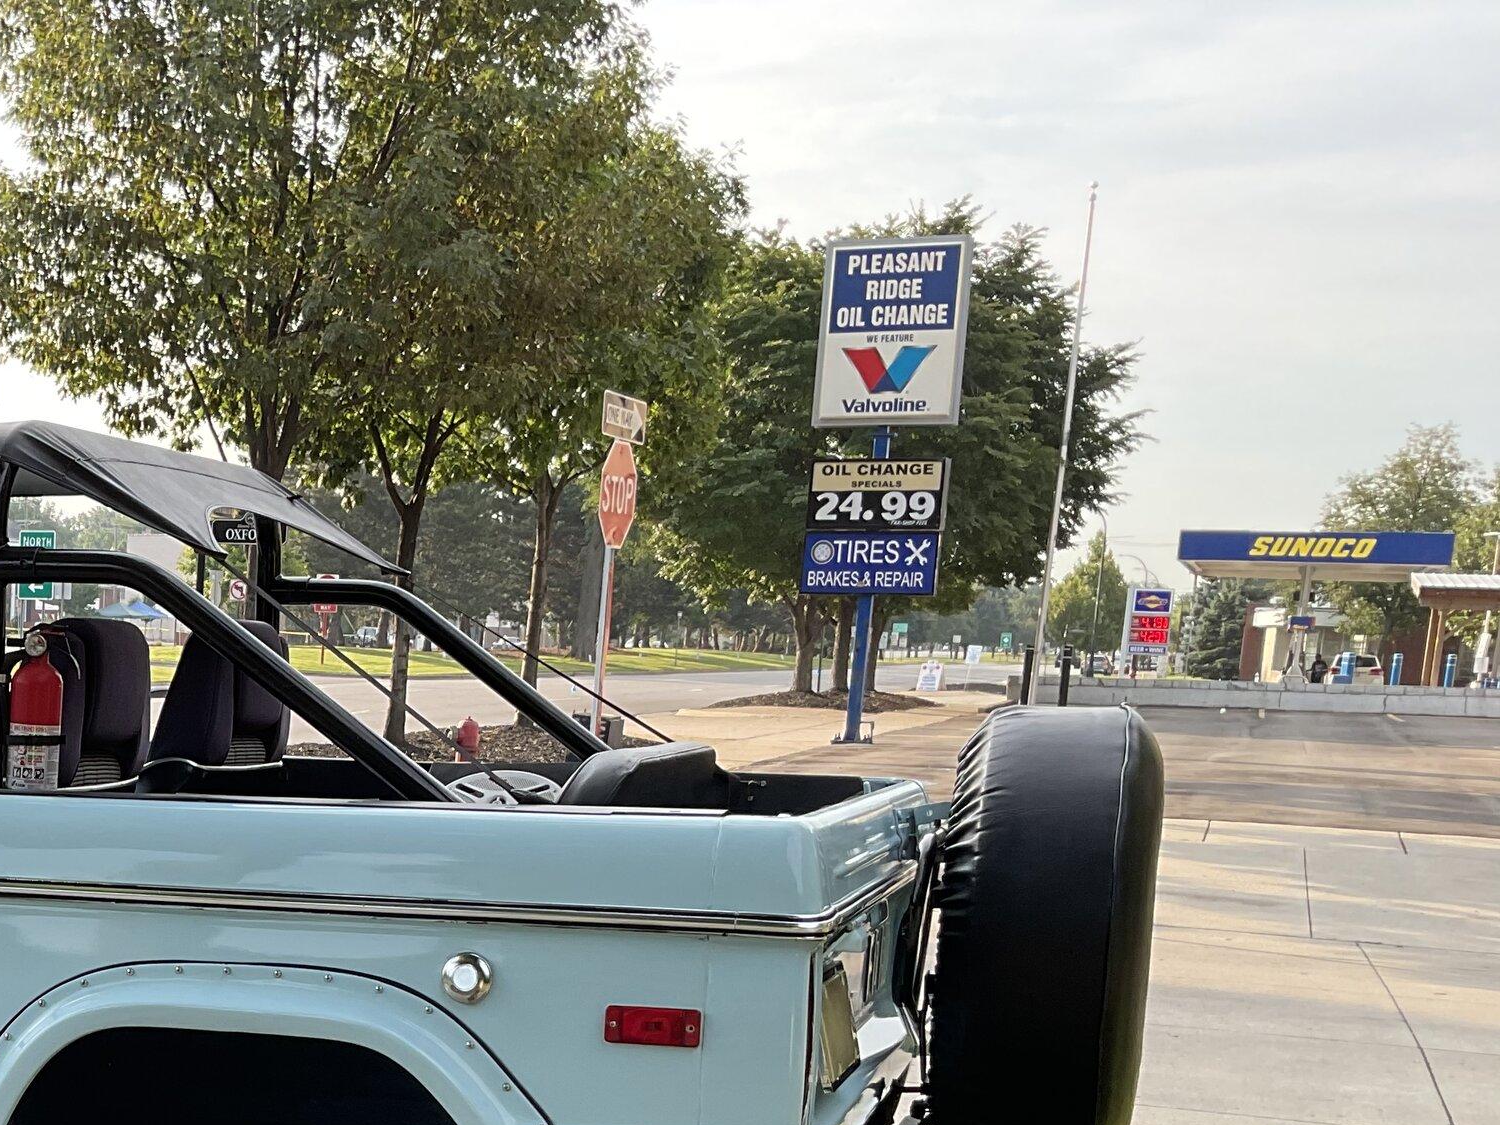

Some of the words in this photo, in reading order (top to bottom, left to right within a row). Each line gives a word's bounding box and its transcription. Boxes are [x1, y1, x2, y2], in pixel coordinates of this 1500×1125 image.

[848, 251, 946, 275] PLEASANT
[865, 278, 923, 300] RIDGE
[836, 306, 865, 328] OIL
[871, 303, 949, 327] CHANGE
[866, 335, 879, 343] WE
[881, 333, 914, 343] FEATURE
[842, 398, 927, 414] Valvoline
[822, 464, 851, 476] OIL
[857, 463, 934, 476] CHANGE
[851, 480, 902, 488] SPECIALS
[602, 475, 634, 515] STOP
[815, 491, 936, 521] 24.99
[22, 536, 52, 547] NORTH
[225, 528, 257, 541] OXFO
[833, 540, 900, 564] TIRES
[1249, 536, 1377, 558] SUNOCO
[807, 571, 859, 587] BRAKES
[862, 571, 871, 587] &
[874, 571, 924, 587] REPAIR
